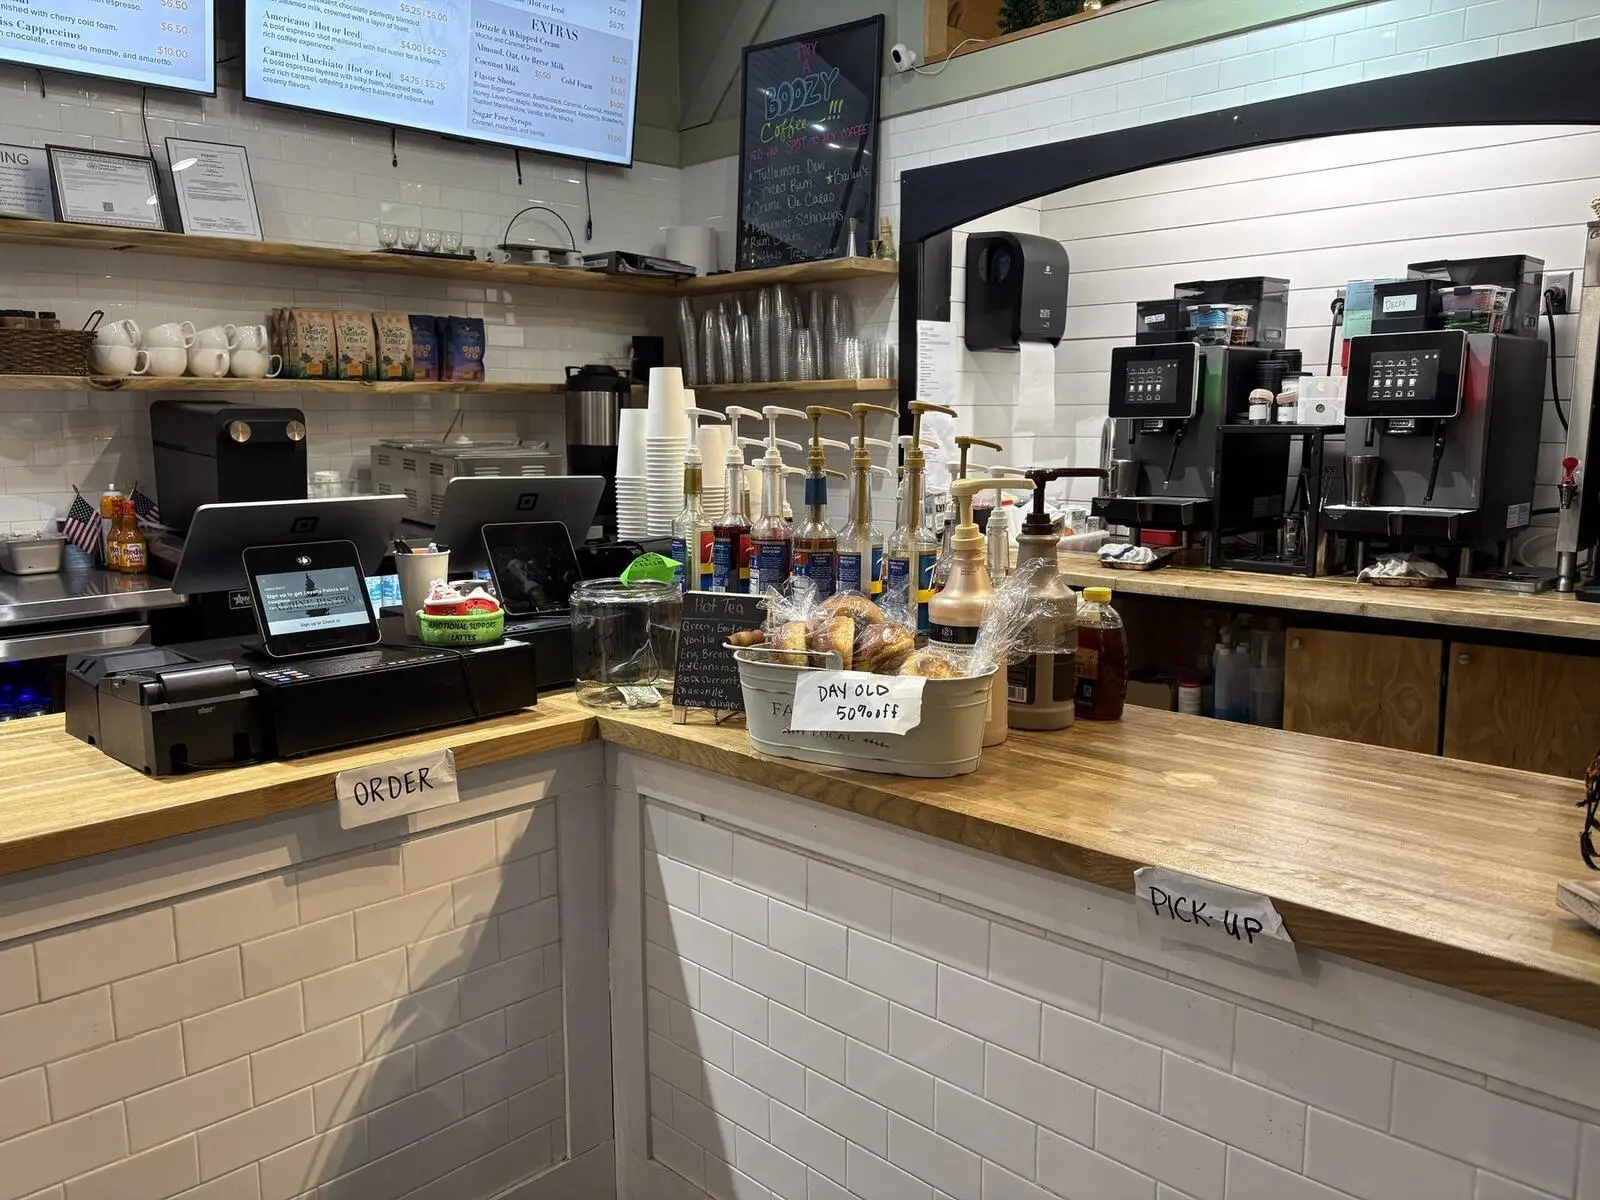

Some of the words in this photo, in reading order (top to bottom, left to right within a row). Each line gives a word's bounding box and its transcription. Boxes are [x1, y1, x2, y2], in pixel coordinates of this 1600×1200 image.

[323, 8, 351, 19] crowned
[400, 3, 421, 15] $5.25
[31, 8, 48, 18] with
[50, 12, 76, 24] cherry
[78, 18, 94, 27] cold
[96, 21, 118, 31] foam.
[263, 10, 311, 28] Americano
[331, 26, 342, 35] or
[17, 20, 80, 40] Cappuccino
[161, 22, 188, 35] $6.50
[269, 22, 285, 31] bold
[286, 26, 316, 38] espresso
[475, 19, 501, 33] Drizzle
[508, 28, 538, 44] Whipped
[539, 36, 561, 49] Cream
[532, 18, 579, 41] EXTRAS
[263, 30, 276, 39] rich
[277, 33, 299, 44] coffee
[6, 31, 48, 45] chocolate,
[78, 43, 88, 51] de
[90, 46, 121, 58] menthe,
[122, 51, 137, 60] and
[139, 55, 174, 67] amaretto.
[158, 46, 189, 59] $10.00
[400, 40, 423, 53] $4.00
[263, 45, 300, 61] Caramel
[301, 52, 344, 70] Macchiato
[364, 68, 374, 76] or
[475, 42, 505, 57] Almond,
[551, 60, 566, 71] Milk
[285, 62, 315, 74] espresso
[474, 56, 503, 70] Coconut
[504, 62, 520, 74] Milk
[399, 73, 421, 86] $4.75
[424, 78, 447, 91] $5.25
[561, 77, 577, 87] Cold
[765, 67, 840, 120] BOOZY
[761, 117, 807, 143] Coffee
[1, 151, 28, 165] ING
[754, 165, 801, 181] Tullamore
[790, 179, 813, 193] Rum
[695, 597, 718, 614] Hot
[722, 598, 744, 615] Tea
[428, 621, 468, 629] EMOTIONAL
[469, 621, 496, 630] SUPPORT
[682, 621, 714, 632] Green,
[693, 662, 737, 673] Cinnamo
[818, 682, 847, 702] DAY
[855, 684, 889, 697] OLD
[812, 730, 855, 743] LOCAL
[354, 767, 433, 806] ORDER
